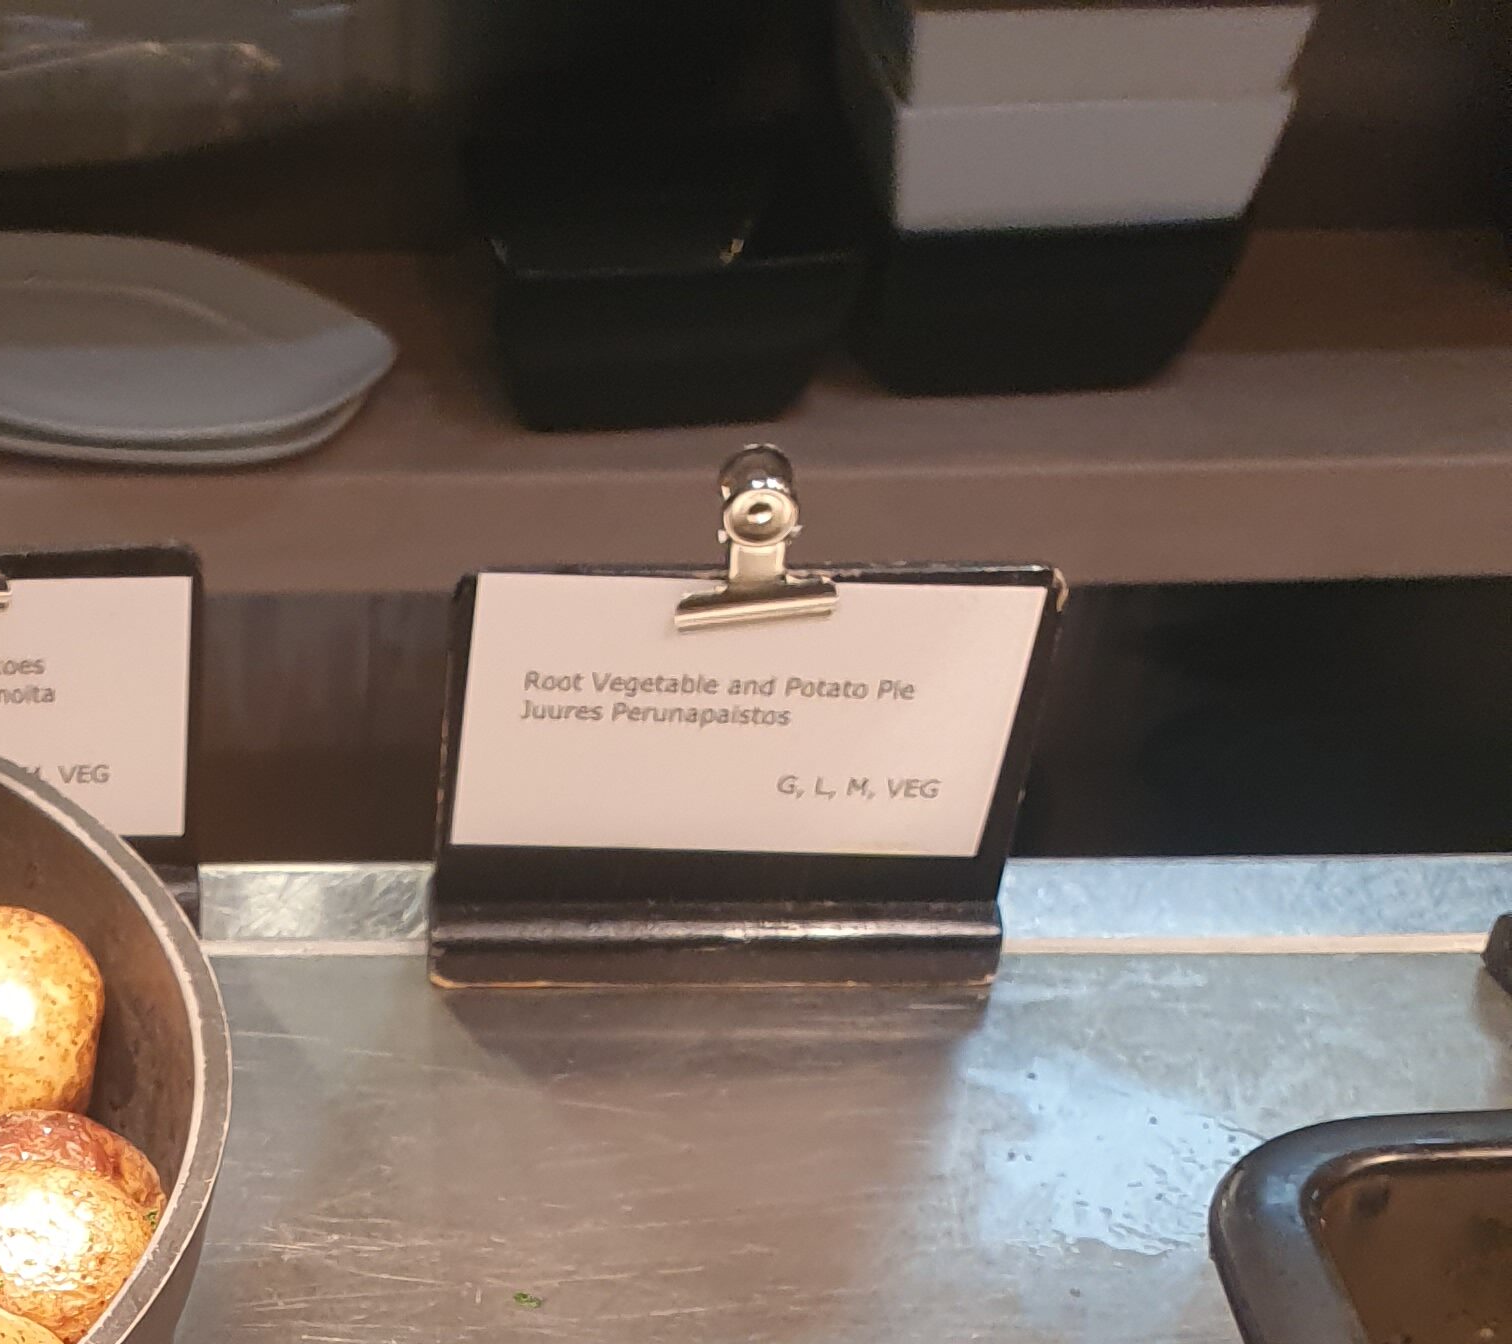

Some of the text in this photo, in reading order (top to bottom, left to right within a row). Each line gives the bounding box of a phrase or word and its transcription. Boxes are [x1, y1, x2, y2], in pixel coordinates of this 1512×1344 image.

[523, 670, 915, 700] Root Vegetable and Potato Pie
[520, 700, 792, 730] Juures Perunapaistos
[57, 764, 110, 784] VEG
[776, 774, 943, 801] G, L, M, VEG
